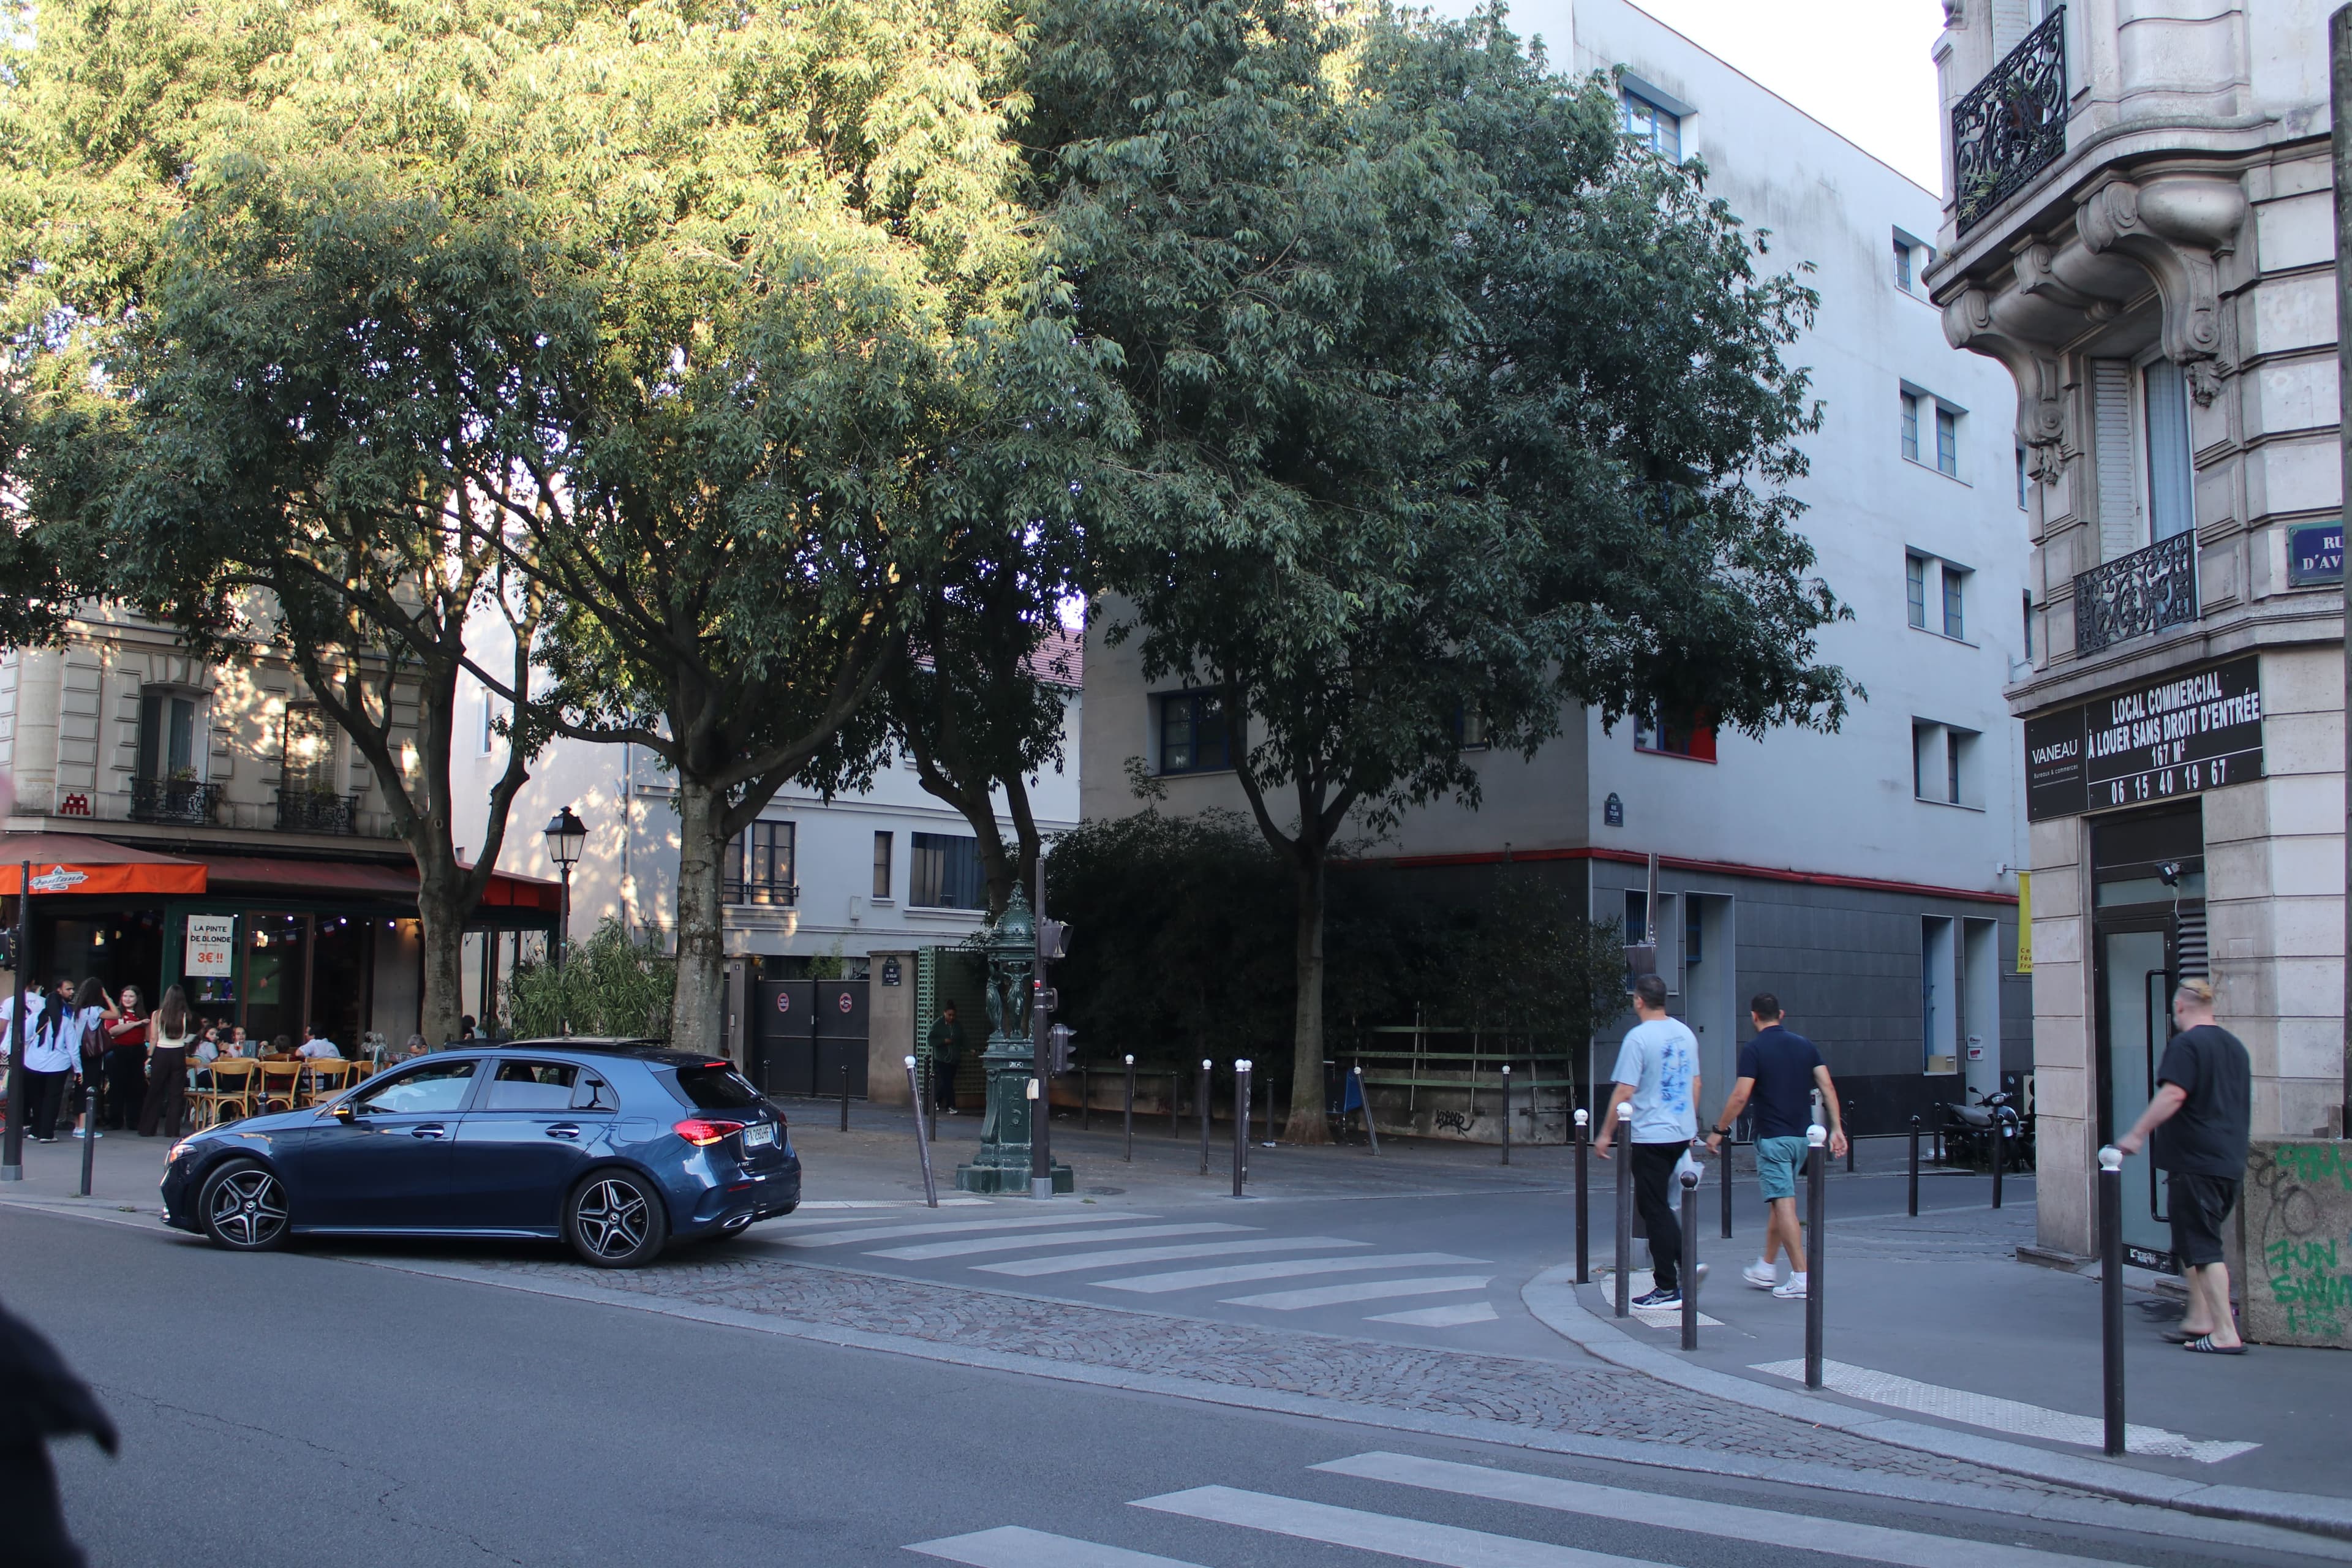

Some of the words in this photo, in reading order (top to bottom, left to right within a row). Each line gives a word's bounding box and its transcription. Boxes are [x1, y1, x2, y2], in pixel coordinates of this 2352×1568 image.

[2323, 535, 2343, 549] RU
[2302, 554, 2342, 570] D'AV
[2112, 693, 2145, 725] LOCAL
[2147, 671, 2222, 715] COMMERCIAL
[2087, 729, 2095, 760] À
[2097, 725, 2130, 757] LOUER
[2133, 717, 2160, 748] SANS
[2163, 707, 2197, 741] DROIT
[2201, 687, 2260, 733] D'ENTRÉE
[2032, 739, 2078, 764] VANEAU
[2152, 744, 2169, 767] 167
[2055, 764, 2078, 774] commerces
[2111, 780, 2124, 804] 06
[2135, 775, 2148, 799] 15
[2159, 770, 2173, 794] 40
[2184, 764, 2199, 790] 19
[2211, 759, 2226, 785] 67
[197, 952, 213, 963] 3€
